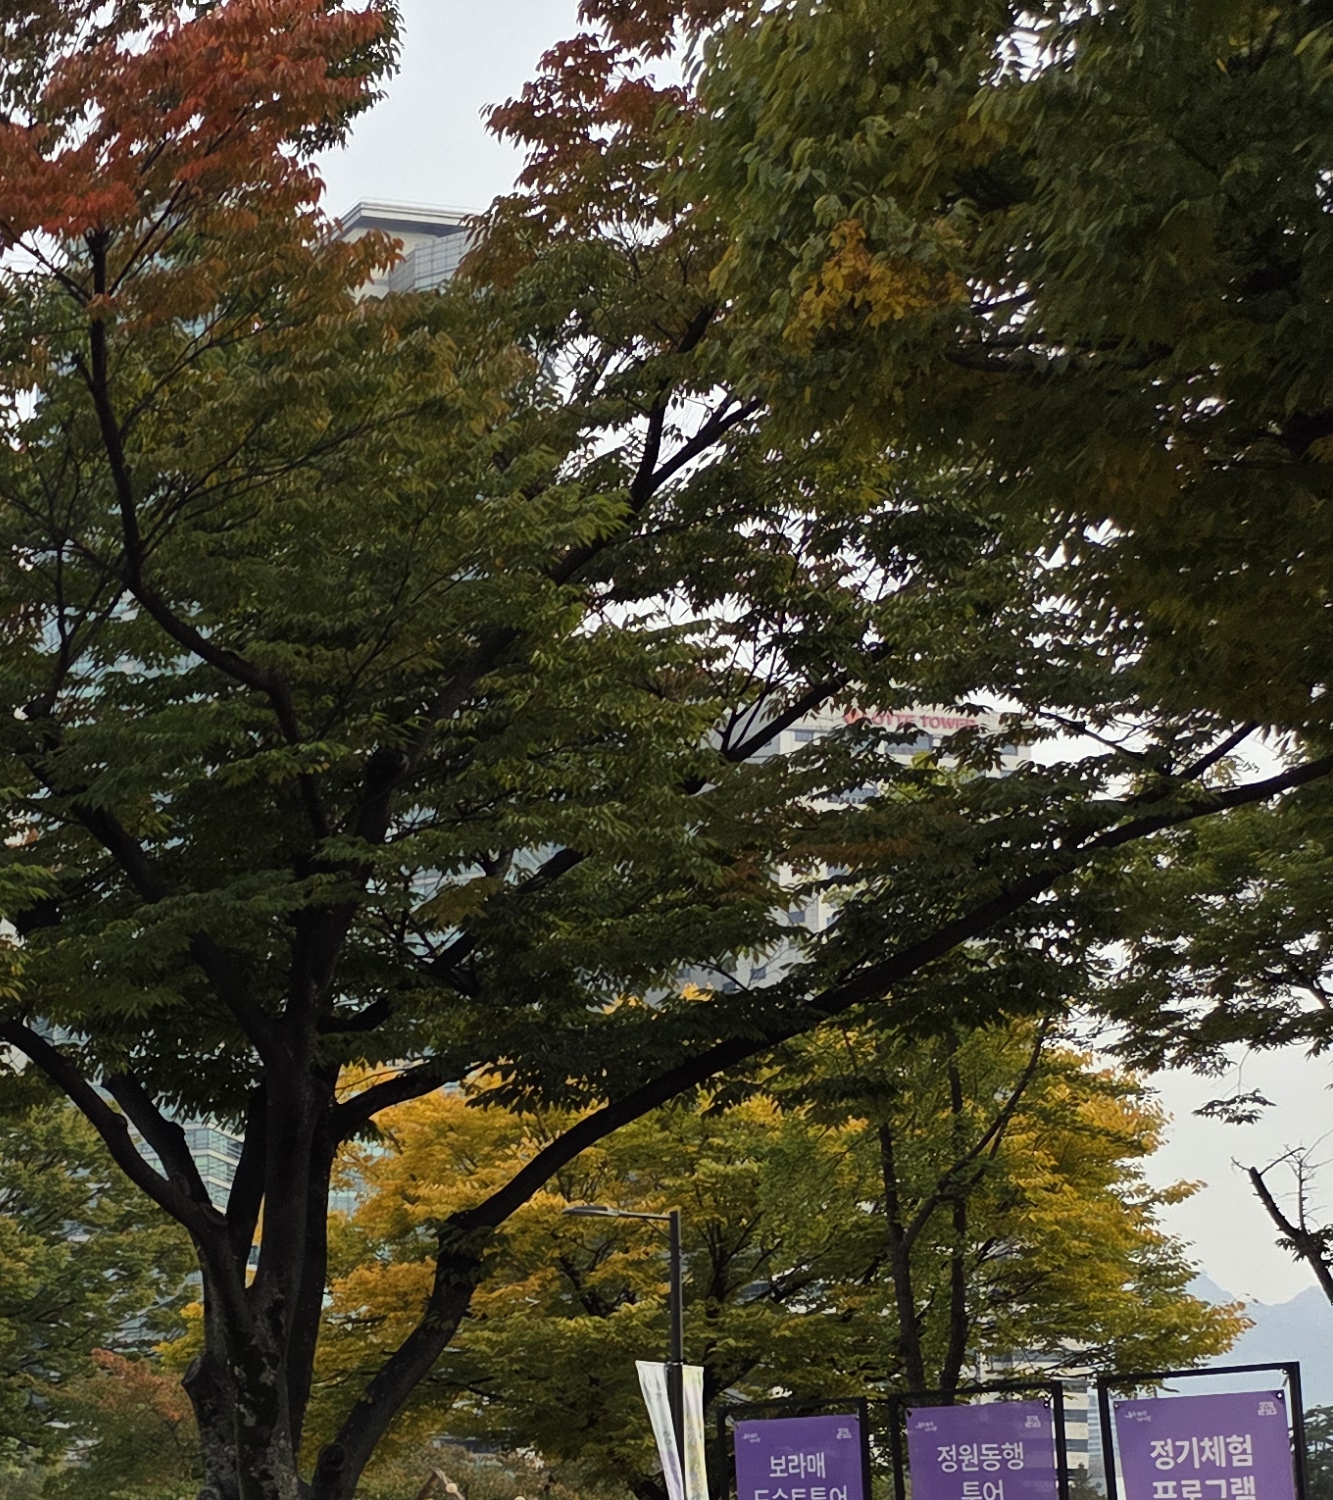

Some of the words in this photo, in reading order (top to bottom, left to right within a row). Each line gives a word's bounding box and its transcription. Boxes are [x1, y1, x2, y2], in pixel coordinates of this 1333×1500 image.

[769, 1452, 826, 1479] 보라매
[937, 1441, 1024, 1473] 정원동행
[1150, 1434, 1254, 1471] 정기체험
